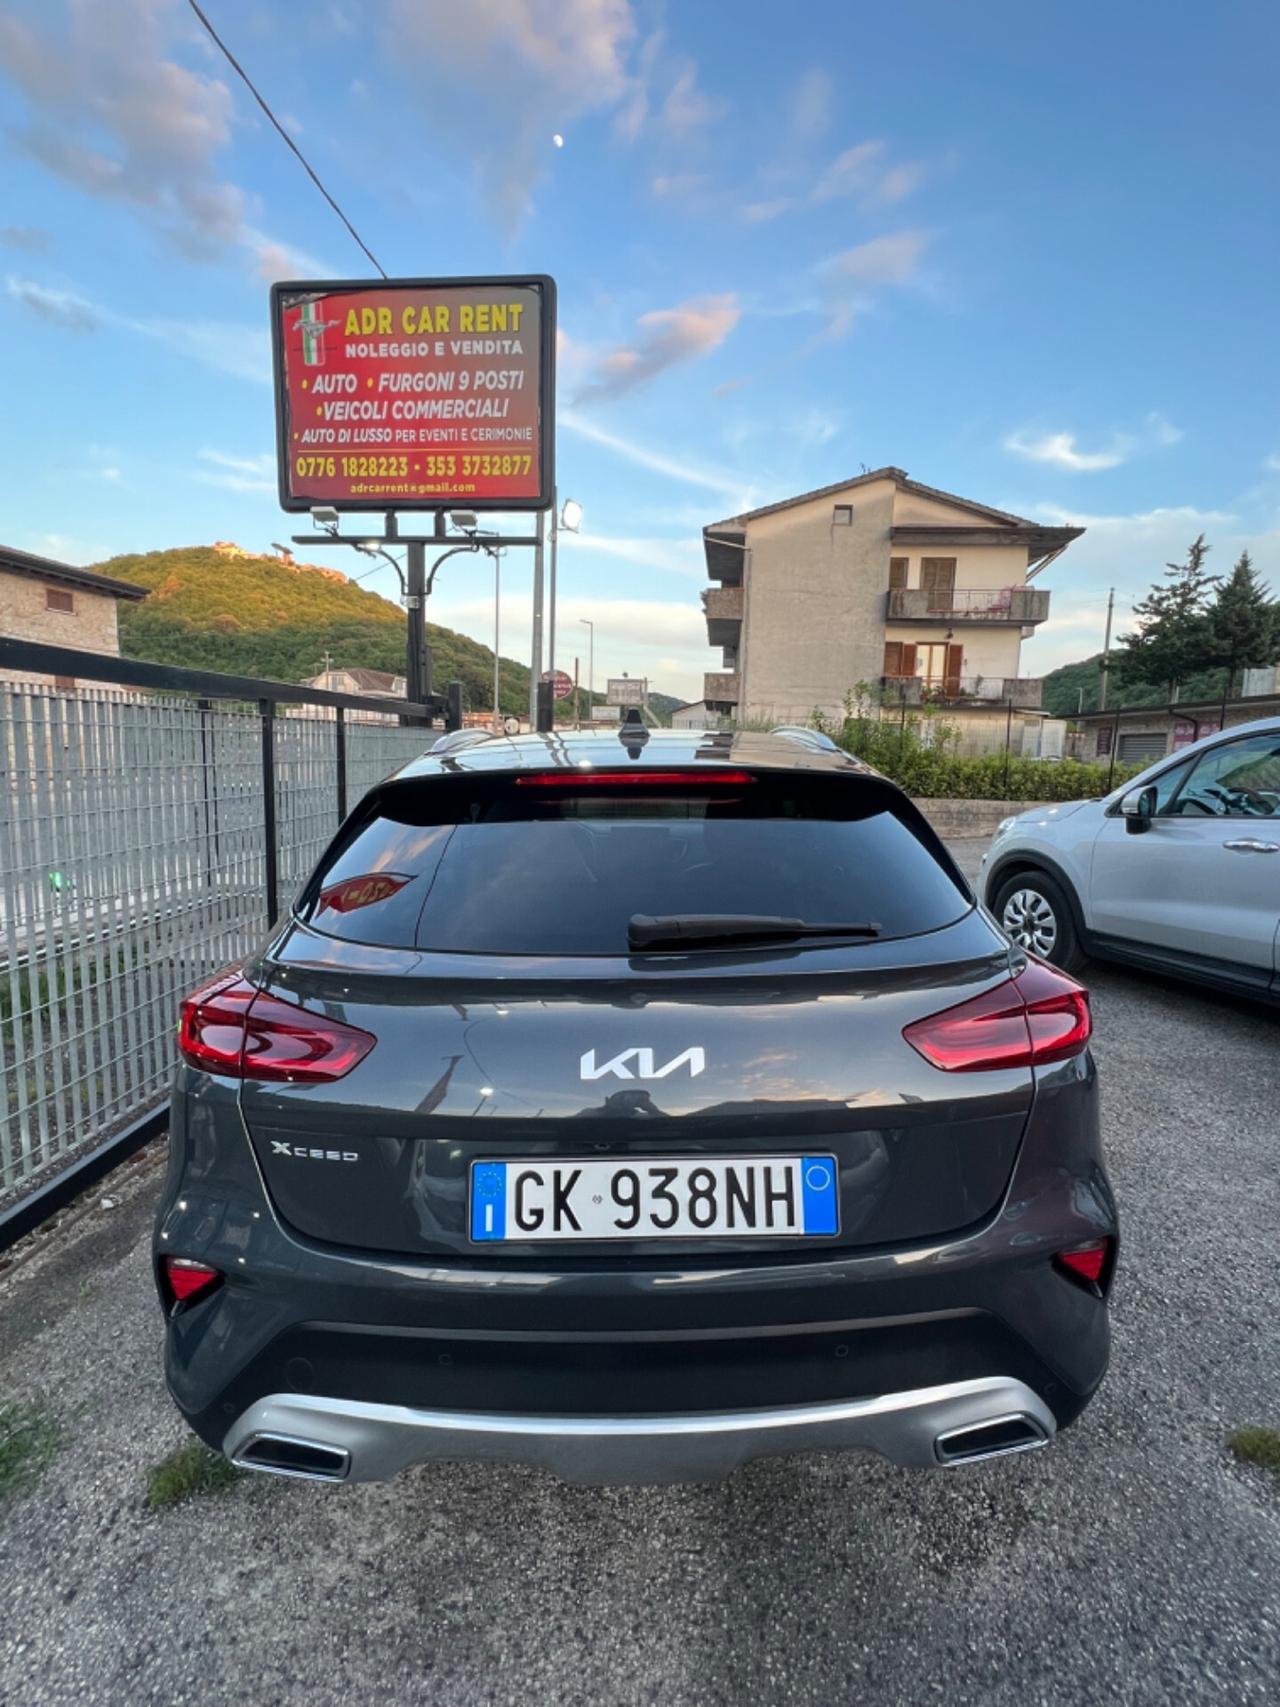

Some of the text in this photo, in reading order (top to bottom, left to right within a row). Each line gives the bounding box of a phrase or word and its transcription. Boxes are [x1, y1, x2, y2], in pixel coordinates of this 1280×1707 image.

[344, 304, 524, 336] ADR CAR RENT
[345, 340, 523, 358] NOLEGGIO E VENDITA
[312, 371, 524, 394] AUTO FURGONI 9 POSTI
[323, 399, 508, 420] VEICOLI COMMERCIALI
[302, 427, 532, 443] AUTO DI LUSSO PER EVENTI E CERIMONIE
[296, 458, 335, 477] 0776
[342, 457, 408, 476] 1828223
[426, 456, 456, 476] 353
[462, 456, 531, 476] 3732877
[514, 1166, 796, 1232] GK 938NH
